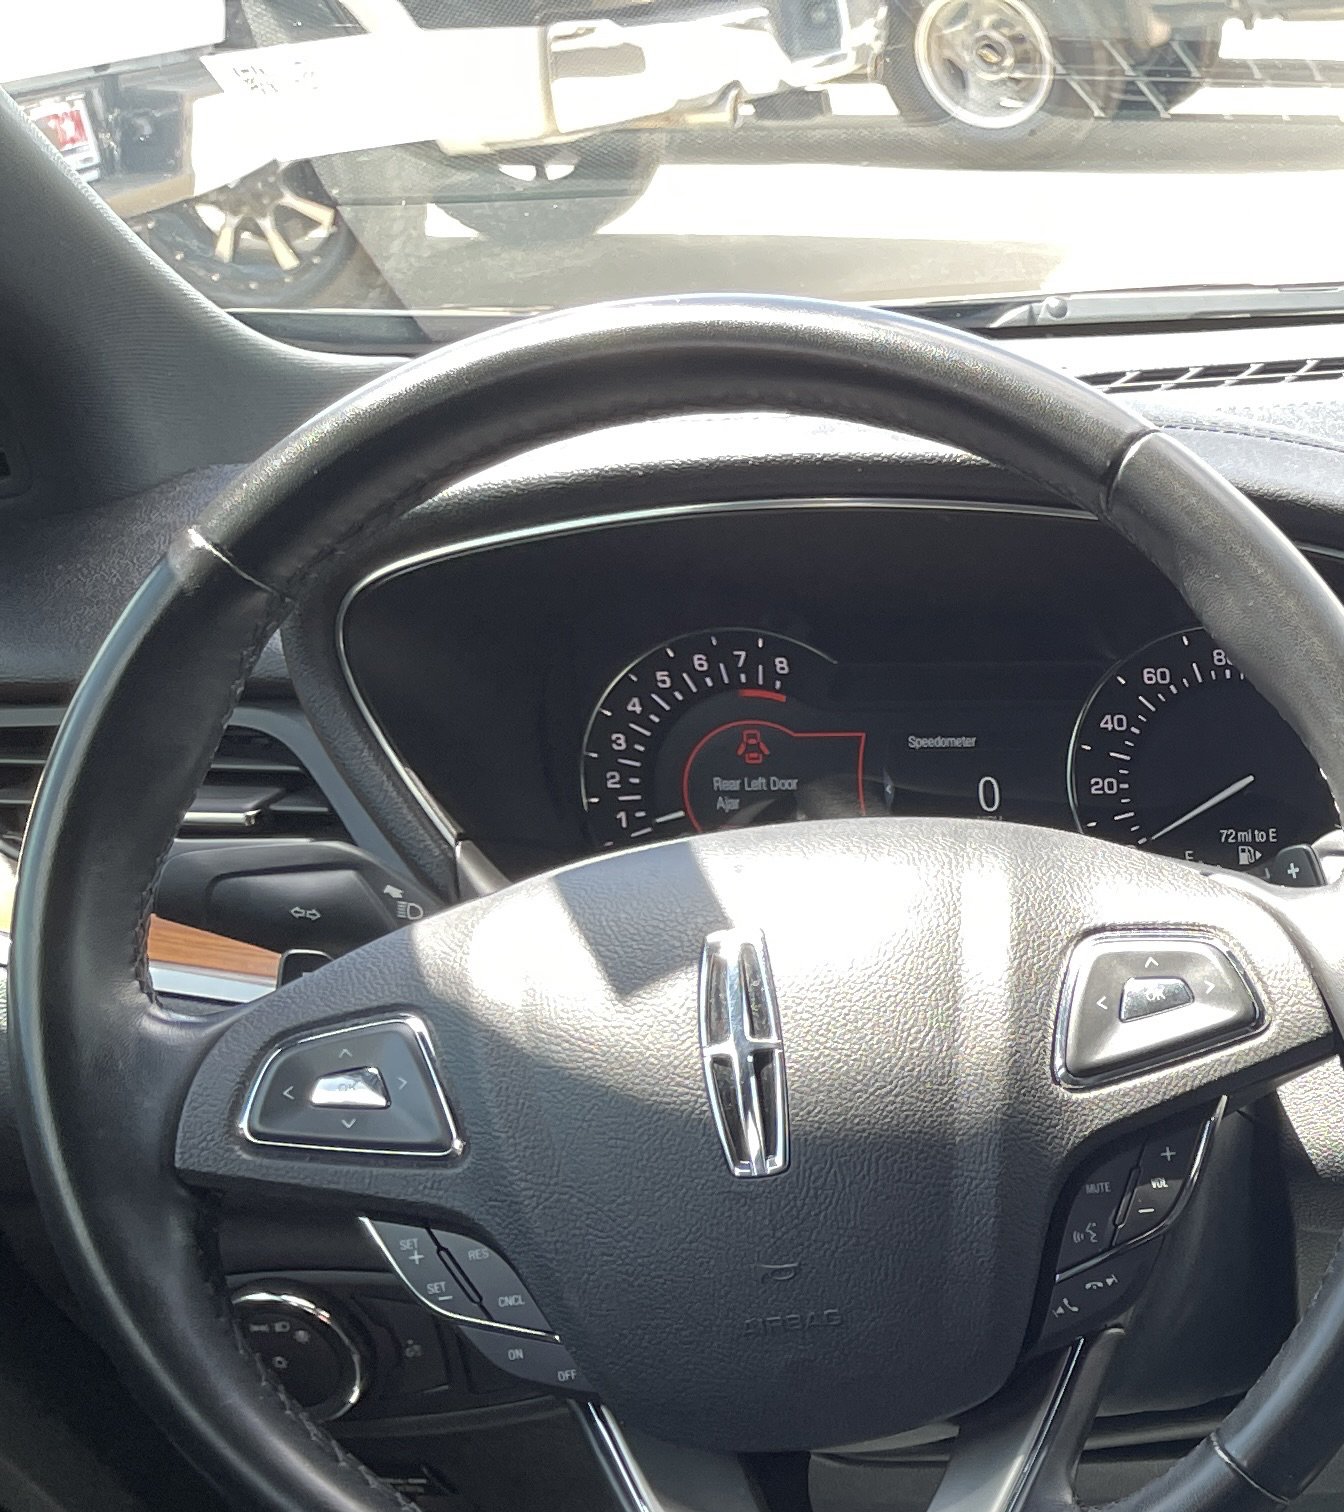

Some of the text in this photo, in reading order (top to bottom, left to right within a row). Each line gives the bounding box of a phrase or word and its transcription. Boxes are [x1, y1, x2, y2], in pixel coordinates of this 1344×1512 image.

[693, 655, 708, 671] 6
[733, 651, 747, 668] 7
[1213, 649, 1232, 666] 8
[775, 658, 789, 674] 8
[656, 672, 671, 688] 5
[1143, 668, 1170, 685] 60
[627, 697, 642, 713] 4
[1100, 714, 1127, 731] 40
[611, 734, 626, 750] 3
[907, 735, 977, 751] Speedometer
[606, 772, 620, 788] 2
[713, 776, 798, 791] Rear Left Door
[1090, 778, 1117, 794] 20
[978, 776, 1000, 812] 0
[616, 810, 628, 828] 1
[1220, 829, 1236, 843] 72
[1255, 829, 1266, 842] to
[1269, 828, 1277, 842] E
[1085, 1182, 1111, 1195] MUTE
[400, 1239, 419, 1251] SET
[468, 1250, 490, 1261] RES
[427, 1282, 446, 1294] SET
[498, 1295, 525, 1307] CNCL
[508, 1349, 524, 1361] ON
[558, 1370, 577, 1382] OFF
